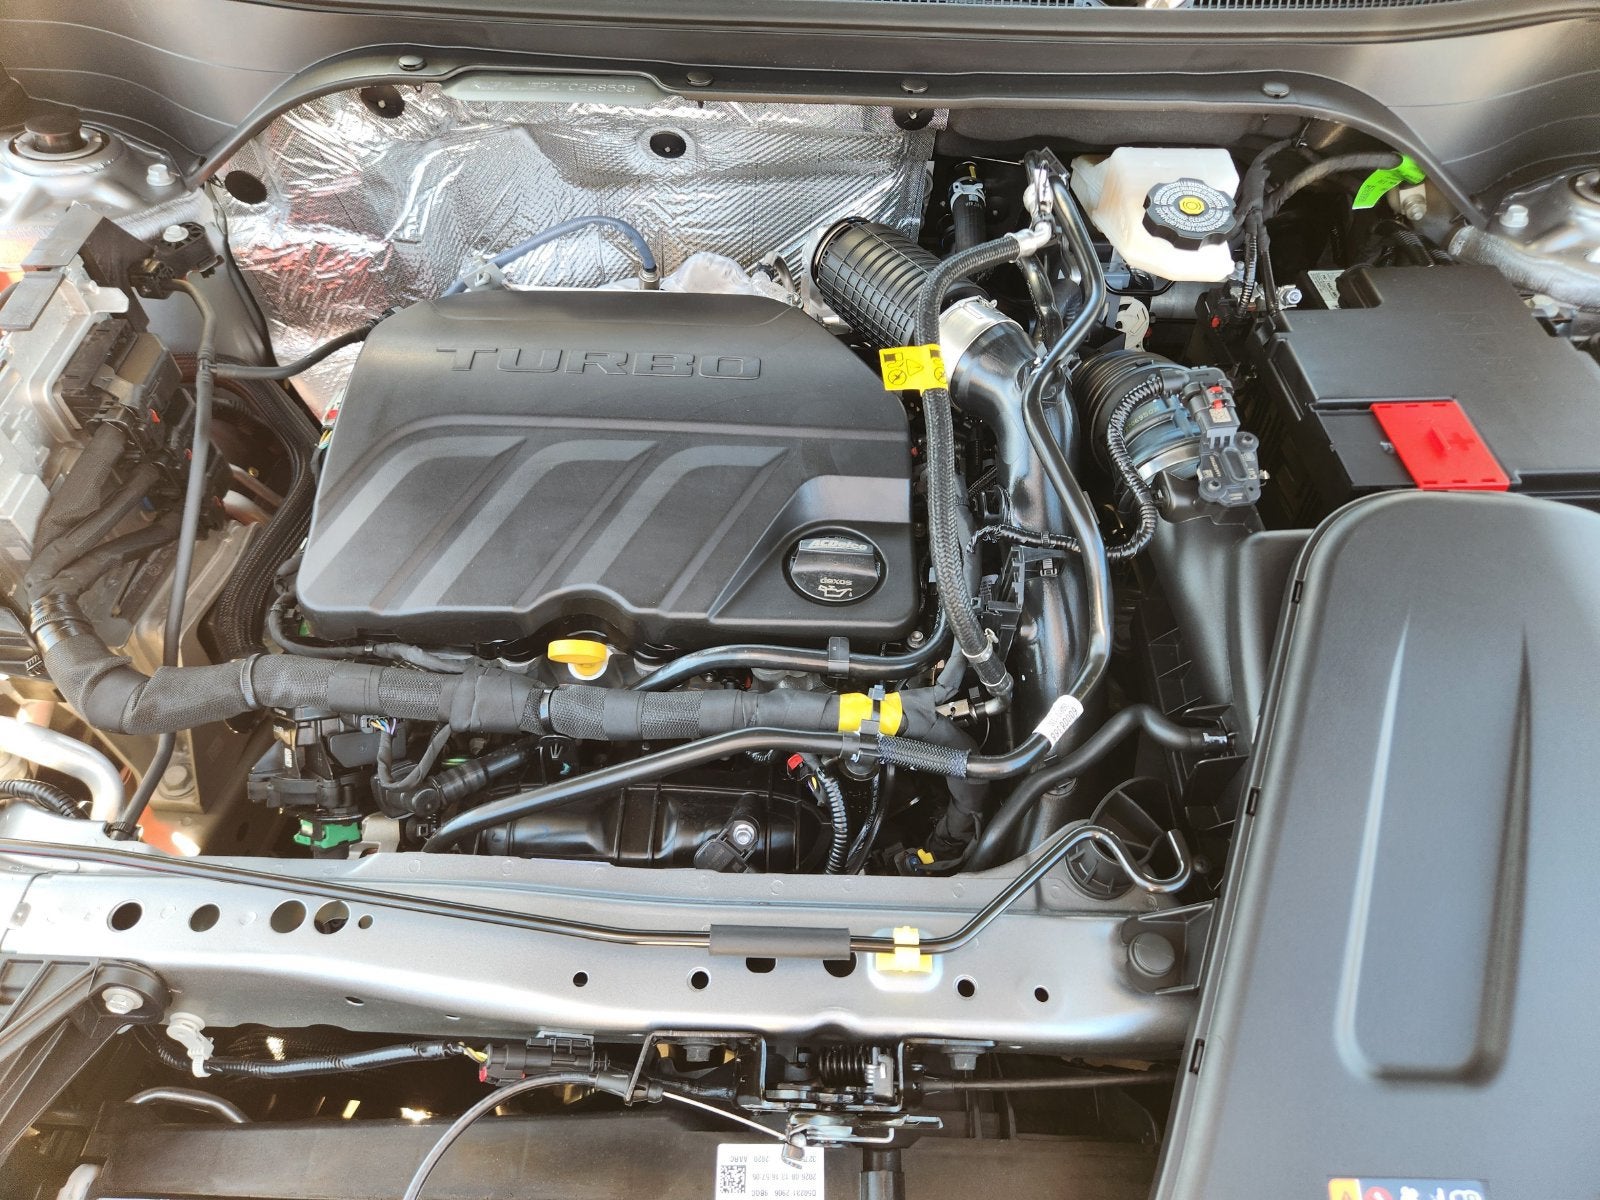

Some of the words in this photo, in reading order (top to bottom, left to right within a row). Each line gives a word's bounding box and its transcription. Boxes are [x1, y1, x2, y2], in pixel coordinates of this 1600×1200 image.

[436, 347, 761, 380] TURBO
[808, 539, 868, 551] ACDelco
[820, 576, 853, 586] dexos
